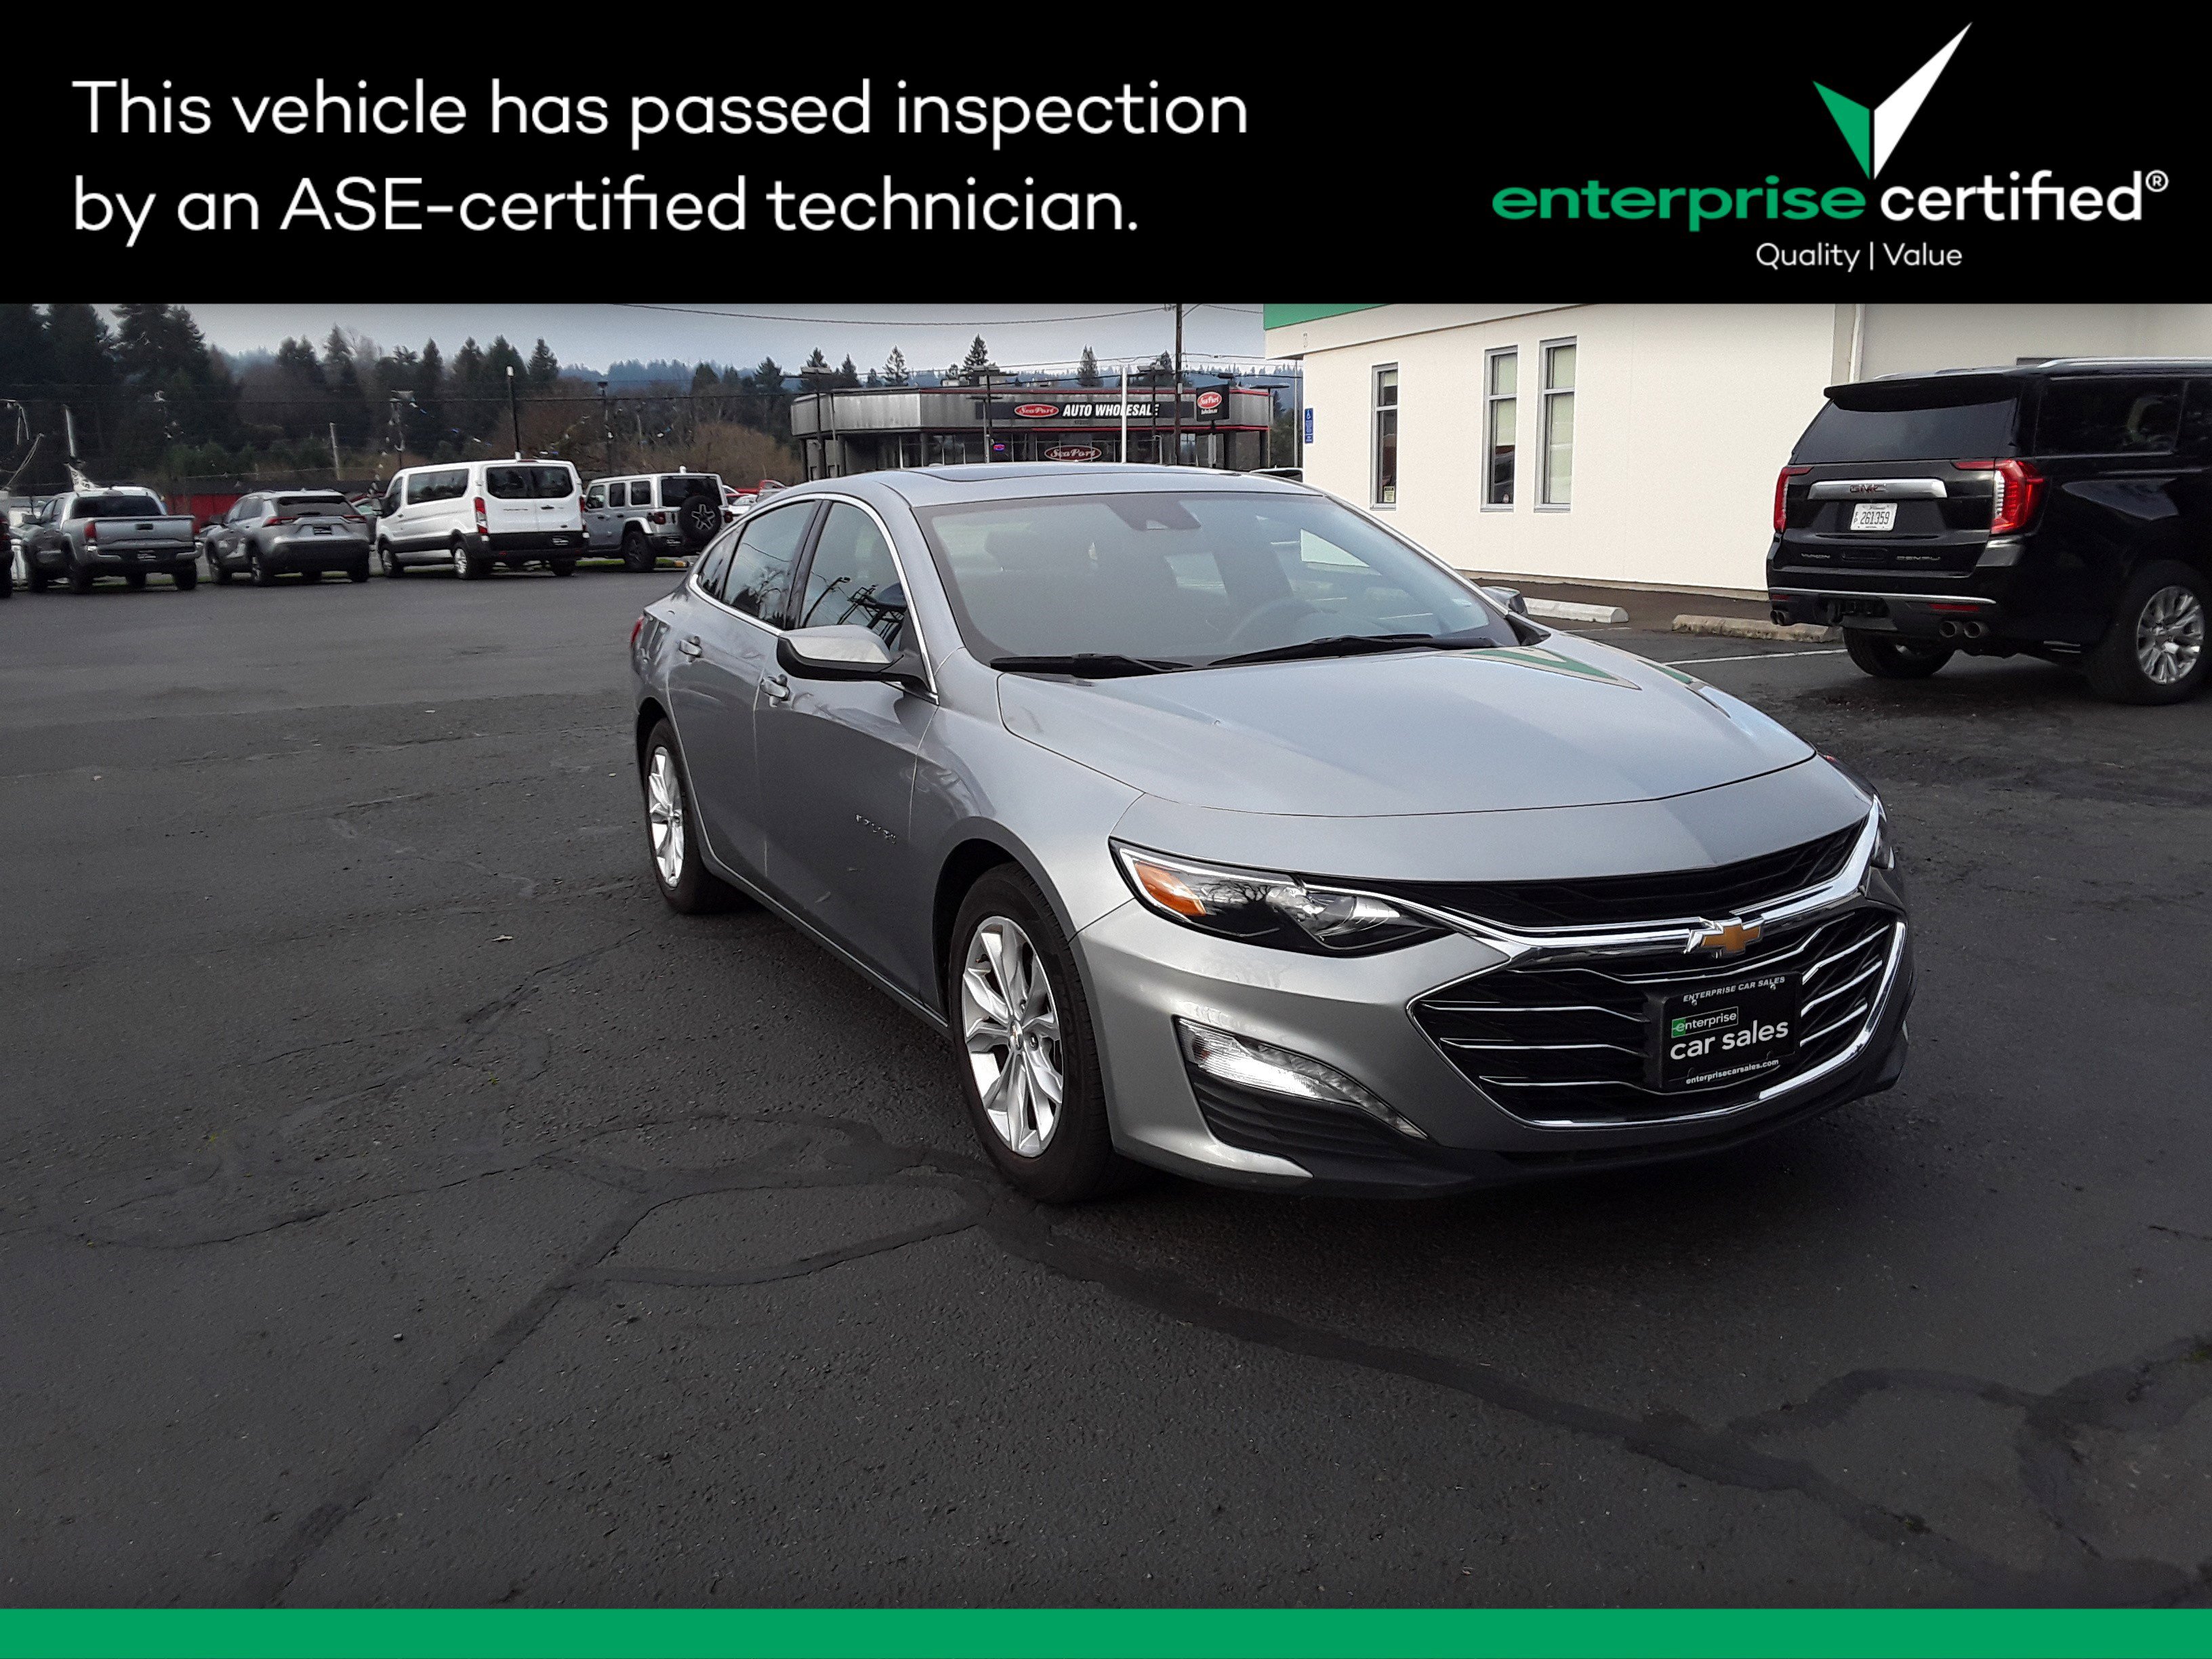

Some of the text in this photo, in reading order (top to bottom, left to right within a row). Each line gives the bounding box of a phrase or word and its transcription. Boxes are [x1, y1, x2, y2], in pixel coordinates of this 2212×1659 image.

[1063, 404, 1092, 417] AUTO
[1860, 511, 1891, 525] 261359
[1683, 976, 1786, 1002] ENTERPRISE CAR SALES
[1674, 1012, 1737, 1032] enterprise
[1670, 1019, 1788, 1061] car sales
[1685, 1059, 1780, 1085] enterprisecarsales.com
